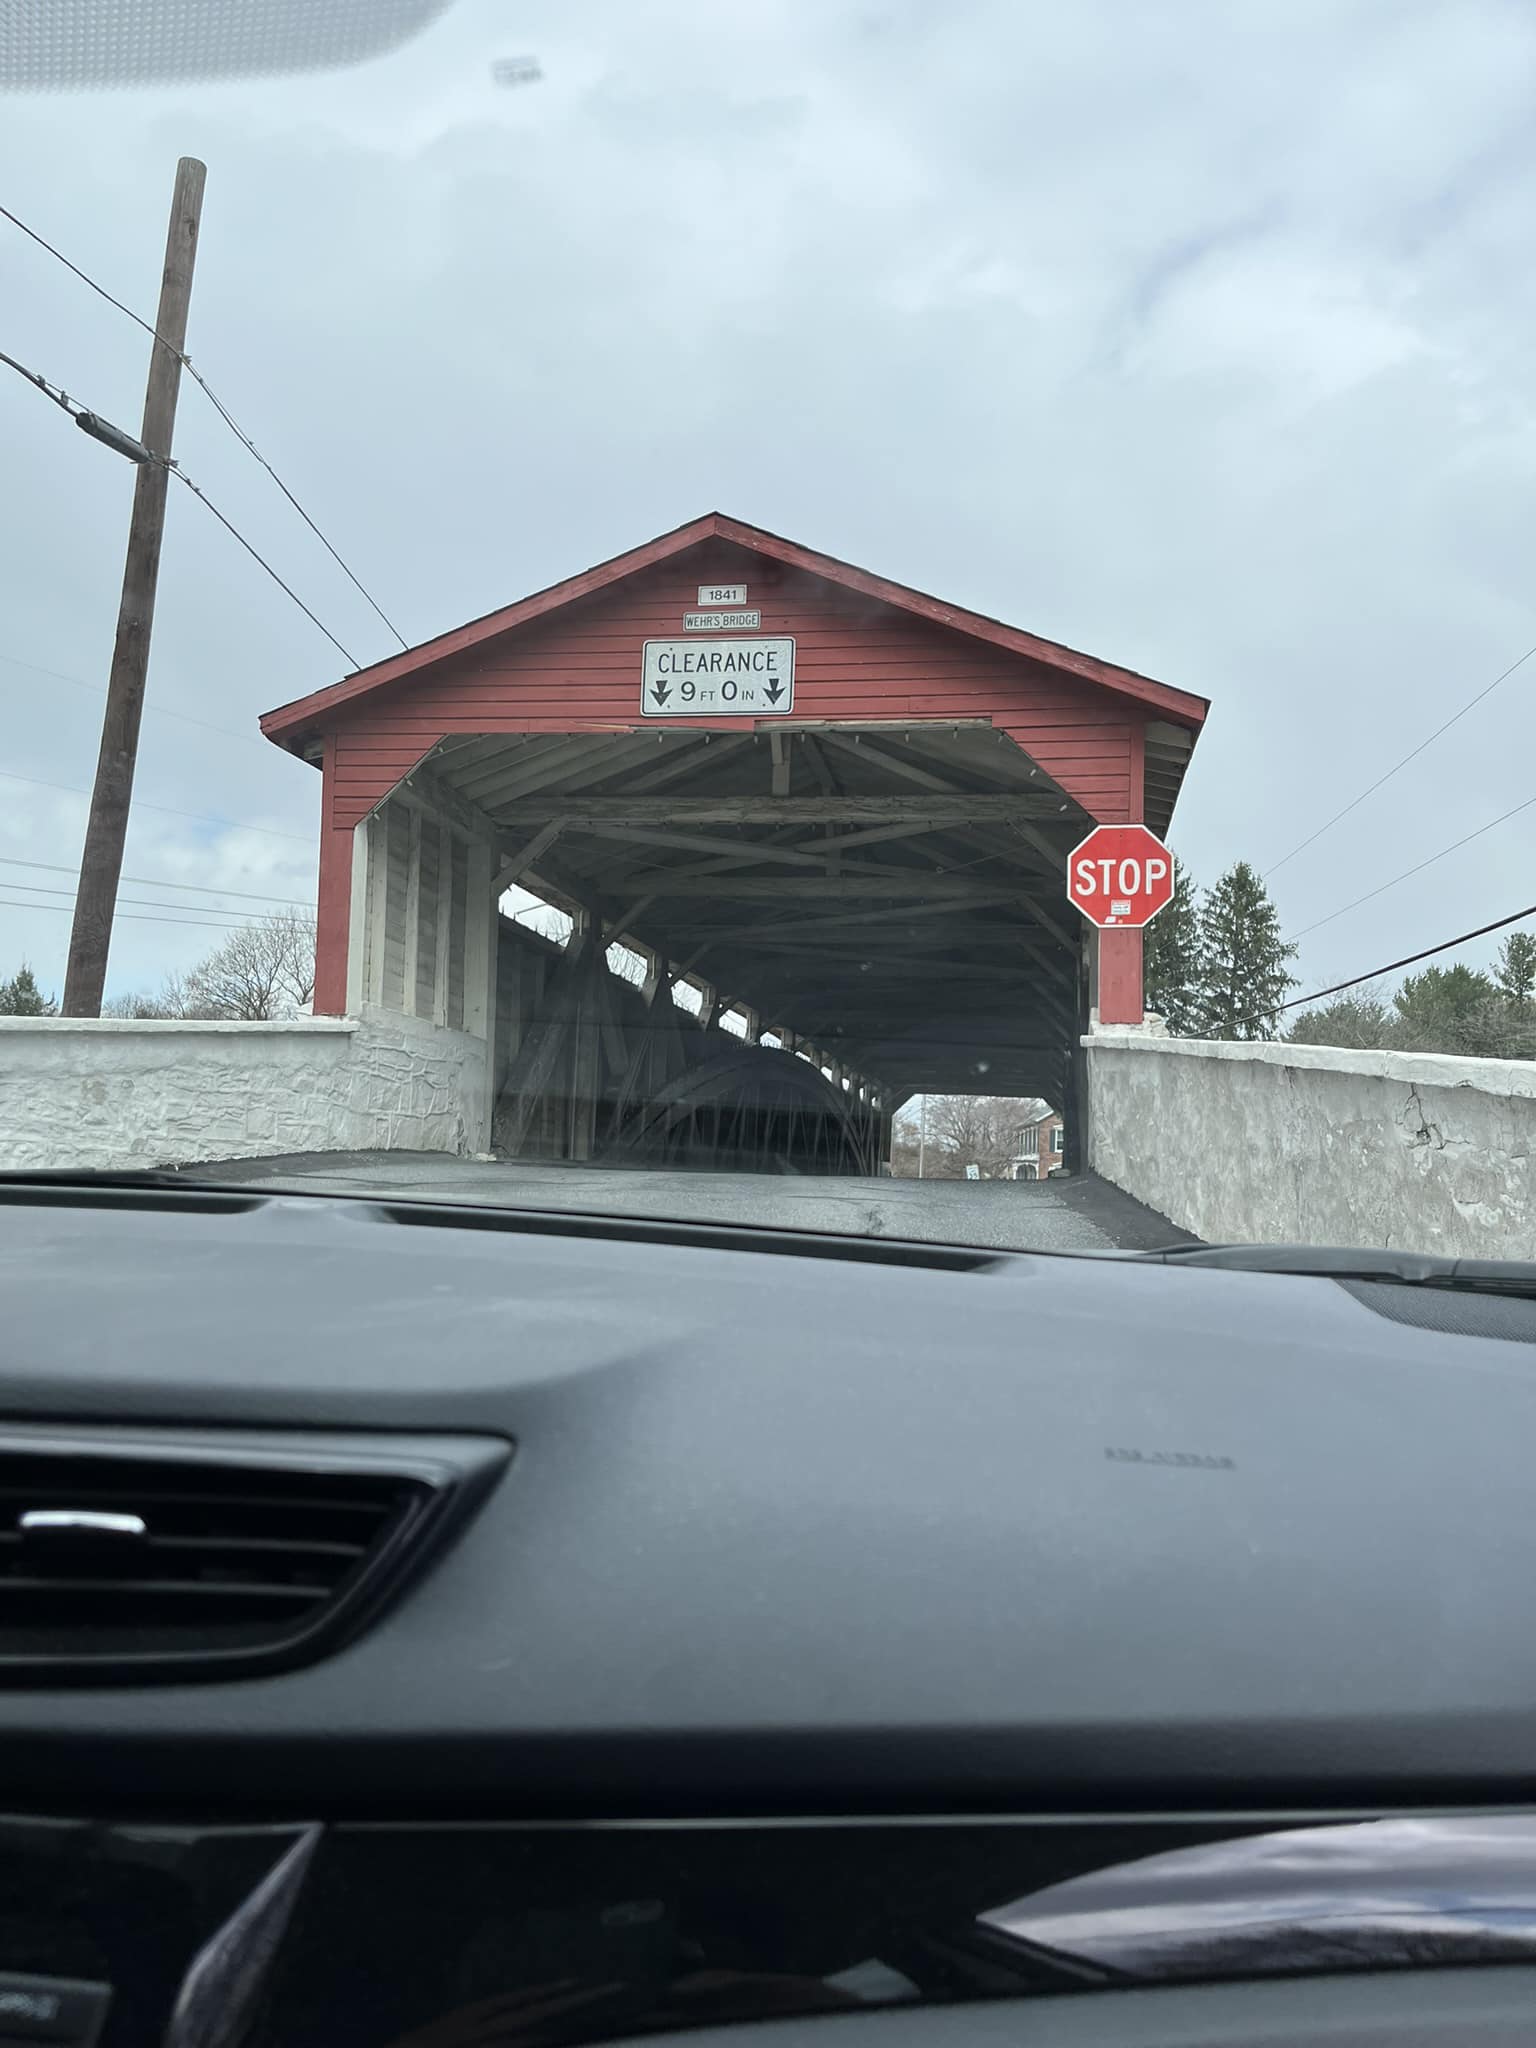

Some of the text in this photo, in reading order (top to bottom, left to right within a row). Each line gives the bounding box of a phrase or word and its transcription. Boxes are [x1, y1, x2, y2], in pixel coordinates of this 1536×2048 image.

[709, 590, 737, 600] 1841
[686, 614, 758, 627] WEHR'S BRIDGE
[658, 651, 777, 673] CLEARANCE
[680, 681, 696, 701] 9
[700, 690, 716, 701] FT
[741, 690, 754, 701] IN
[1075, 858, 1167, 896] STOP
